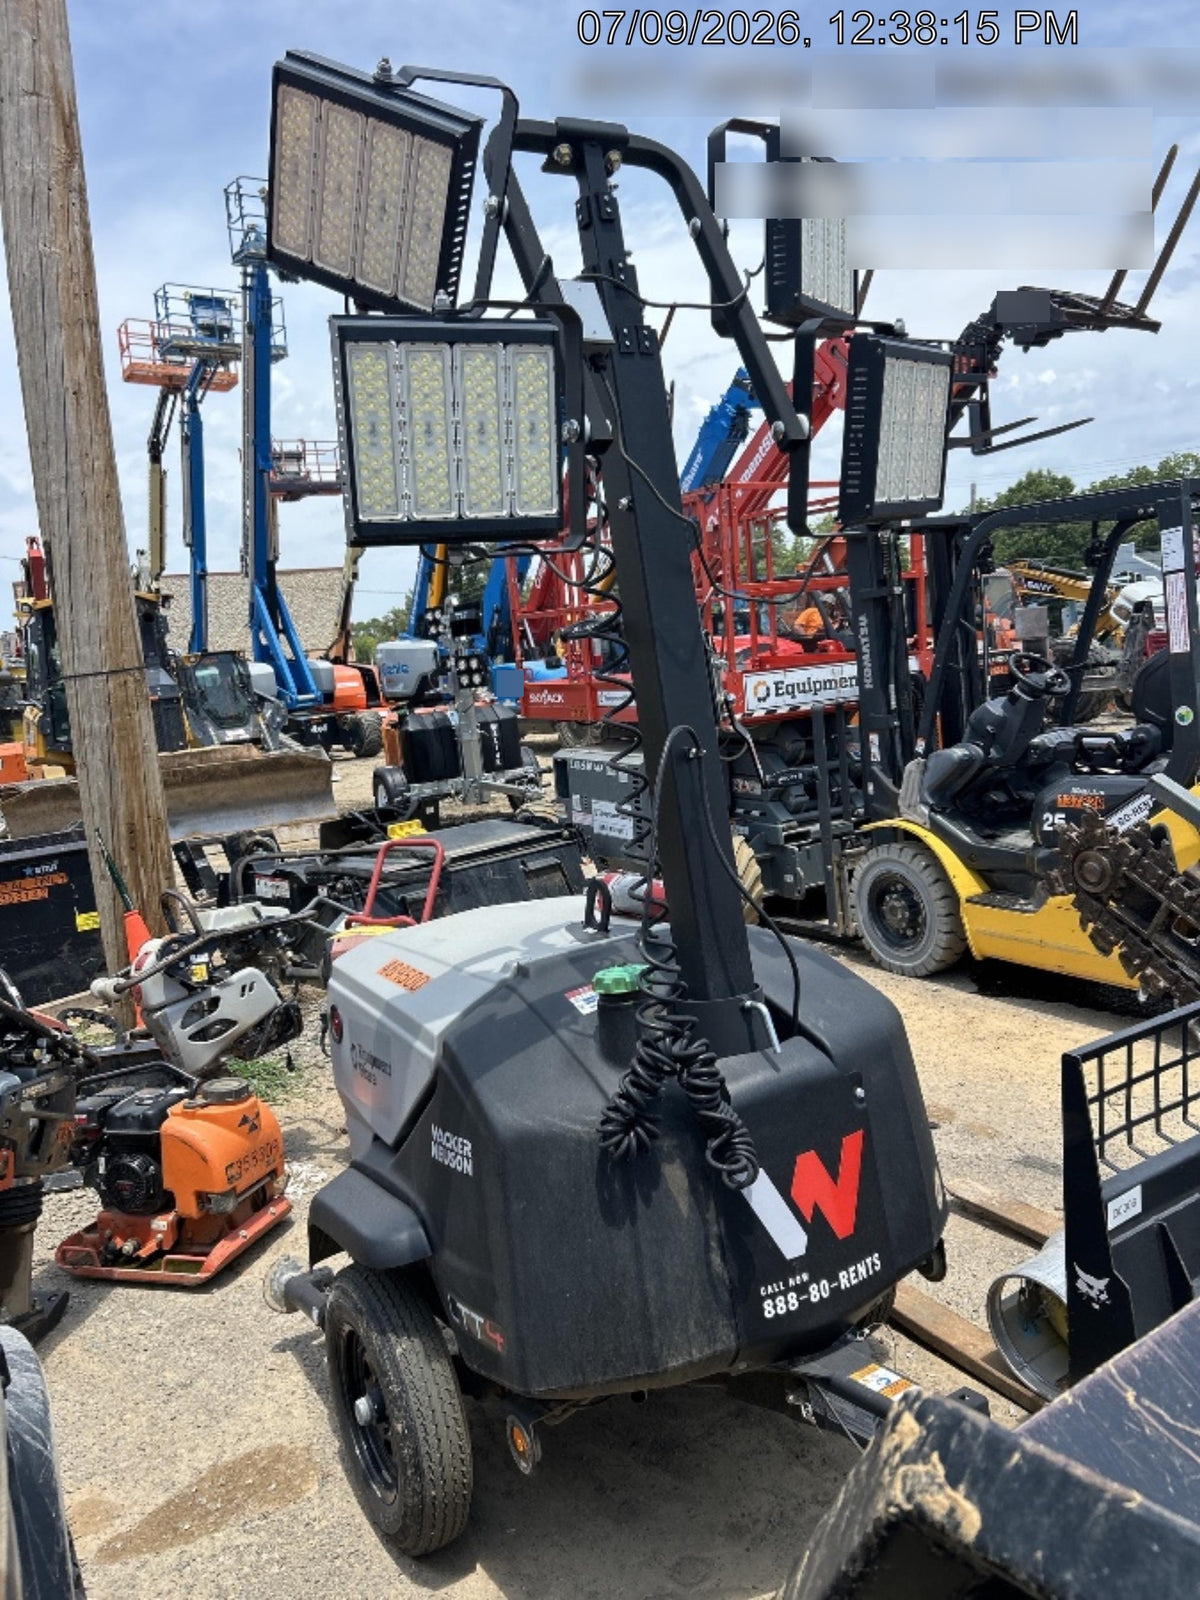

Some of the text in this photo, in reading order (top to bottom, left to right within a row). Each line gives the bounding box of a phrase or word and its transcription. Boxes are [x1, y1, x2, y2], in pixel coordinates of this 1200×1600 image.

[858, 613, 874, 689] KOMATSU
[1042, 812, 1067, 831] 25
[431, 1123, 472, 1158] WACKER
[431, 1141, 474, 1176] NEUSON
[760, 1272, 810, 1297] CALL NOW
[762, 1252, 882, 1319] 888-80-RENTS
